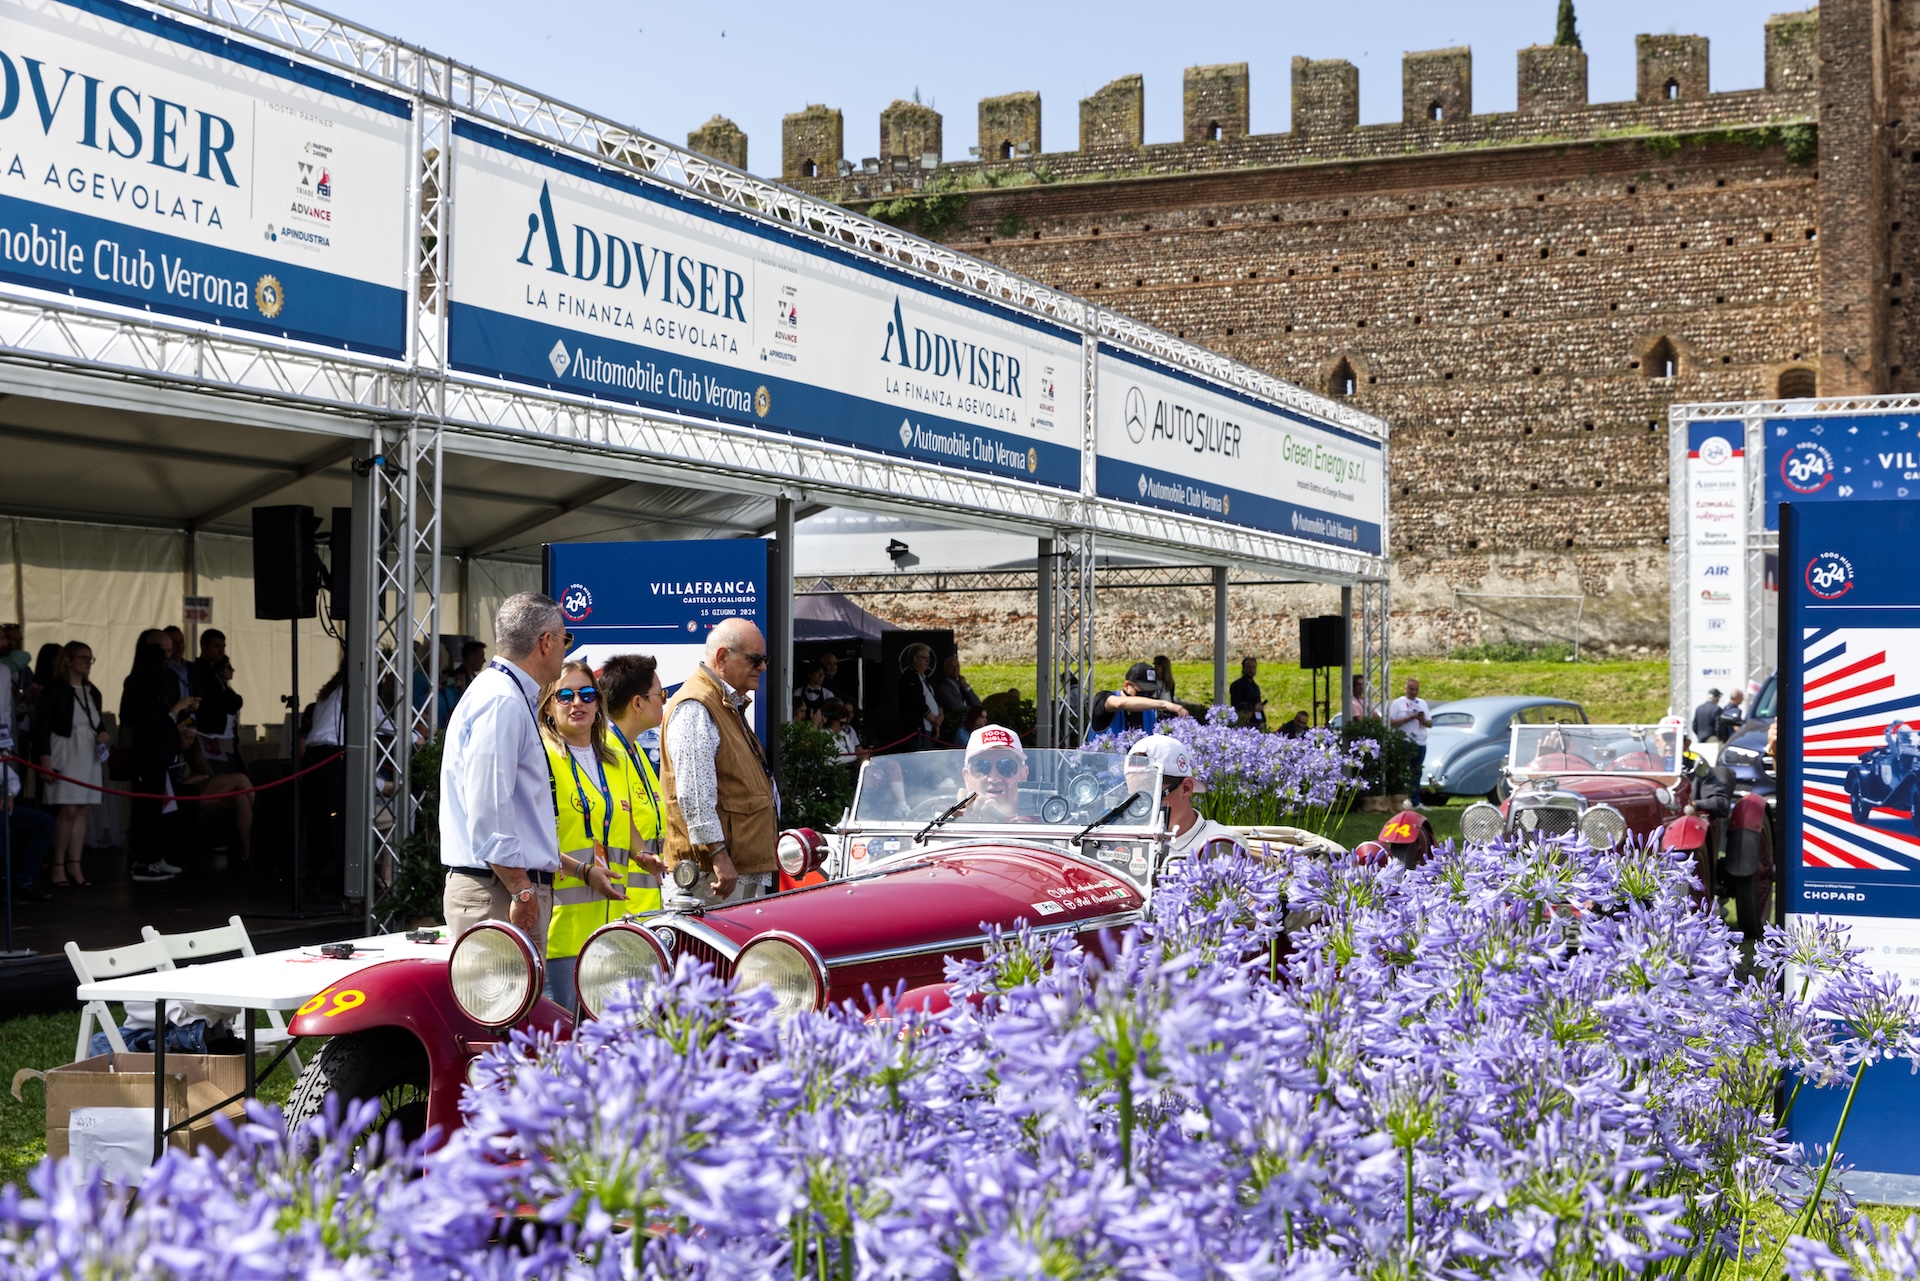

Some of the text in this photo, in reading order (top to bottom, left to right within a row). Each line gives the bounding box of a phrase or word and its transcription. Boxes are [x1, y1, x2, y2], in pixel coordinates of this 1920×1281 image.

[268, 102, 297, 117] NOSTRI
[300, 111, 333, 128] PARTNER
[44, 162, 223, 229] AGEVOLATA
[291, 201, 331, 222] ADVANCE
[281, 226, 330, 247] APINDUSTRIA
[516, 178, 748, 324] ADDVISER
[94, 239, 155, 290] Club
[161, 253, 249, 310] Verona
[526, 284, 738, 355] LA FINANZA AGEVOLATA
[775, 330, 797, 344] ADVANCE
[880, 293, 1022, 399] ADDVISER
[769, 349, 797, 362] APINDUSTRIA
[572, 347, 664, 394] Automobile
[668, 367, 702, 402] Club
[704, 375, 751, 413] Verona
[886, 377, 1017, 424] LA FINANZA AGEVOLATA
[1152, 400, 1241, 459] AUTOSILVER
[913, 423, 971, 459] Automobile
[973, 436, 994, 463] Club
[995, 441, 1025, 470] Verona
[1796, 441, 1818, 450] 1000
[1283, 434, 1312, 468] Green
[1315, 443, 1347, 484] Energy
[1788, 452, 1826, 481] 2024
[1878, 452, 1920, 469] VIL
[1147, 477, 1222, 513] Automobile Club Verona
[1812, 562, 1846, 588] 2024
[1839, 556, 1854, 579] MIGLIA
[650, 581, 756, 595] VILLAFRANCA
[565, 591, 588, 612] 2024
[740, 608, 756, 616] 2024
[1383, 823, 1411, 838] 74
[1803, 890, 1866, 901] CHOPARD
[297, 987, 366, 1017] 69
